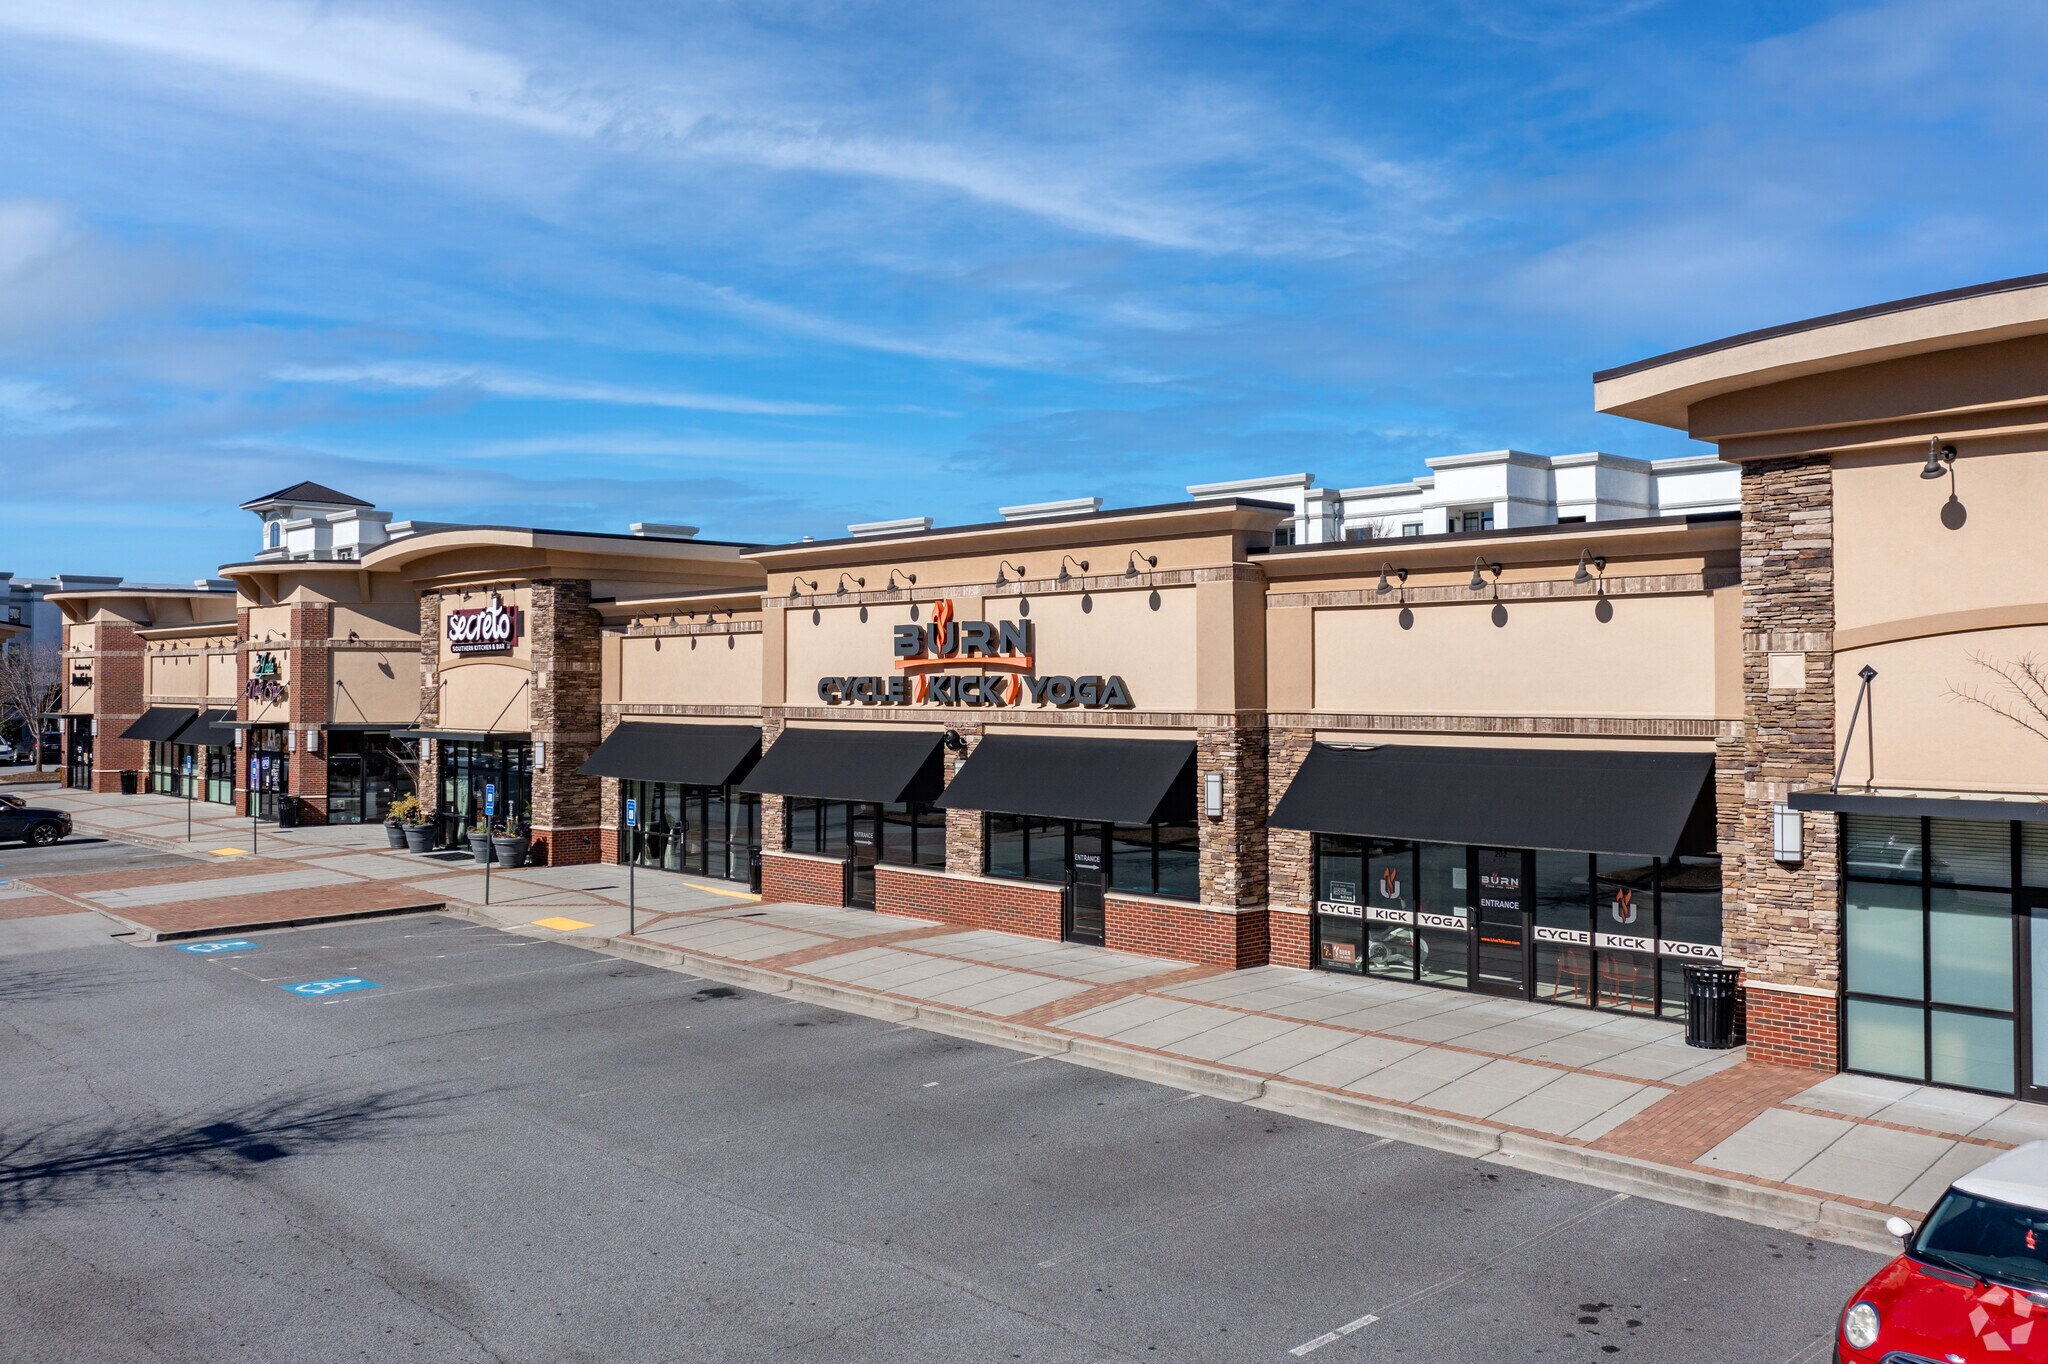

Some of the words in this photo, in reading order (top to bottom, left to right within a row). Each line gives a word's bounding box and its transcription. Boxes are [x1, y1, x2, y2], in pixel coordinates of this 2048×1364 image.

[449, 597, 510, 641] secreto
[894, 618, 1031, 658] BURN
[452, 645, 474, 653] SOUTHERN
[474, 644, 492, 652] KITCHEN
[818, 676, 908, 702] CYCLE
[929, 675, 1003, 704] KICK
[1023, 675, 1131, 706] YOGA
[854, 831, 874, 839] ENTRANCE
[1074, 854, 1101, 863] ENTRANCE
[1481, 875, 1519, 886] BURN
[1481, 898, 1520, 910] ENTRANCE
[1320, 903, 1361, 916] CYCLE
[1375, 910, 1407, 922] KICK
[1421, 914, 1465, 929] YOGA
[1537, 929, 1588, 943] CYCLE
[1606, 936, 1646, 950] KICK
[1663, 942, 1719, 958] YOGA
